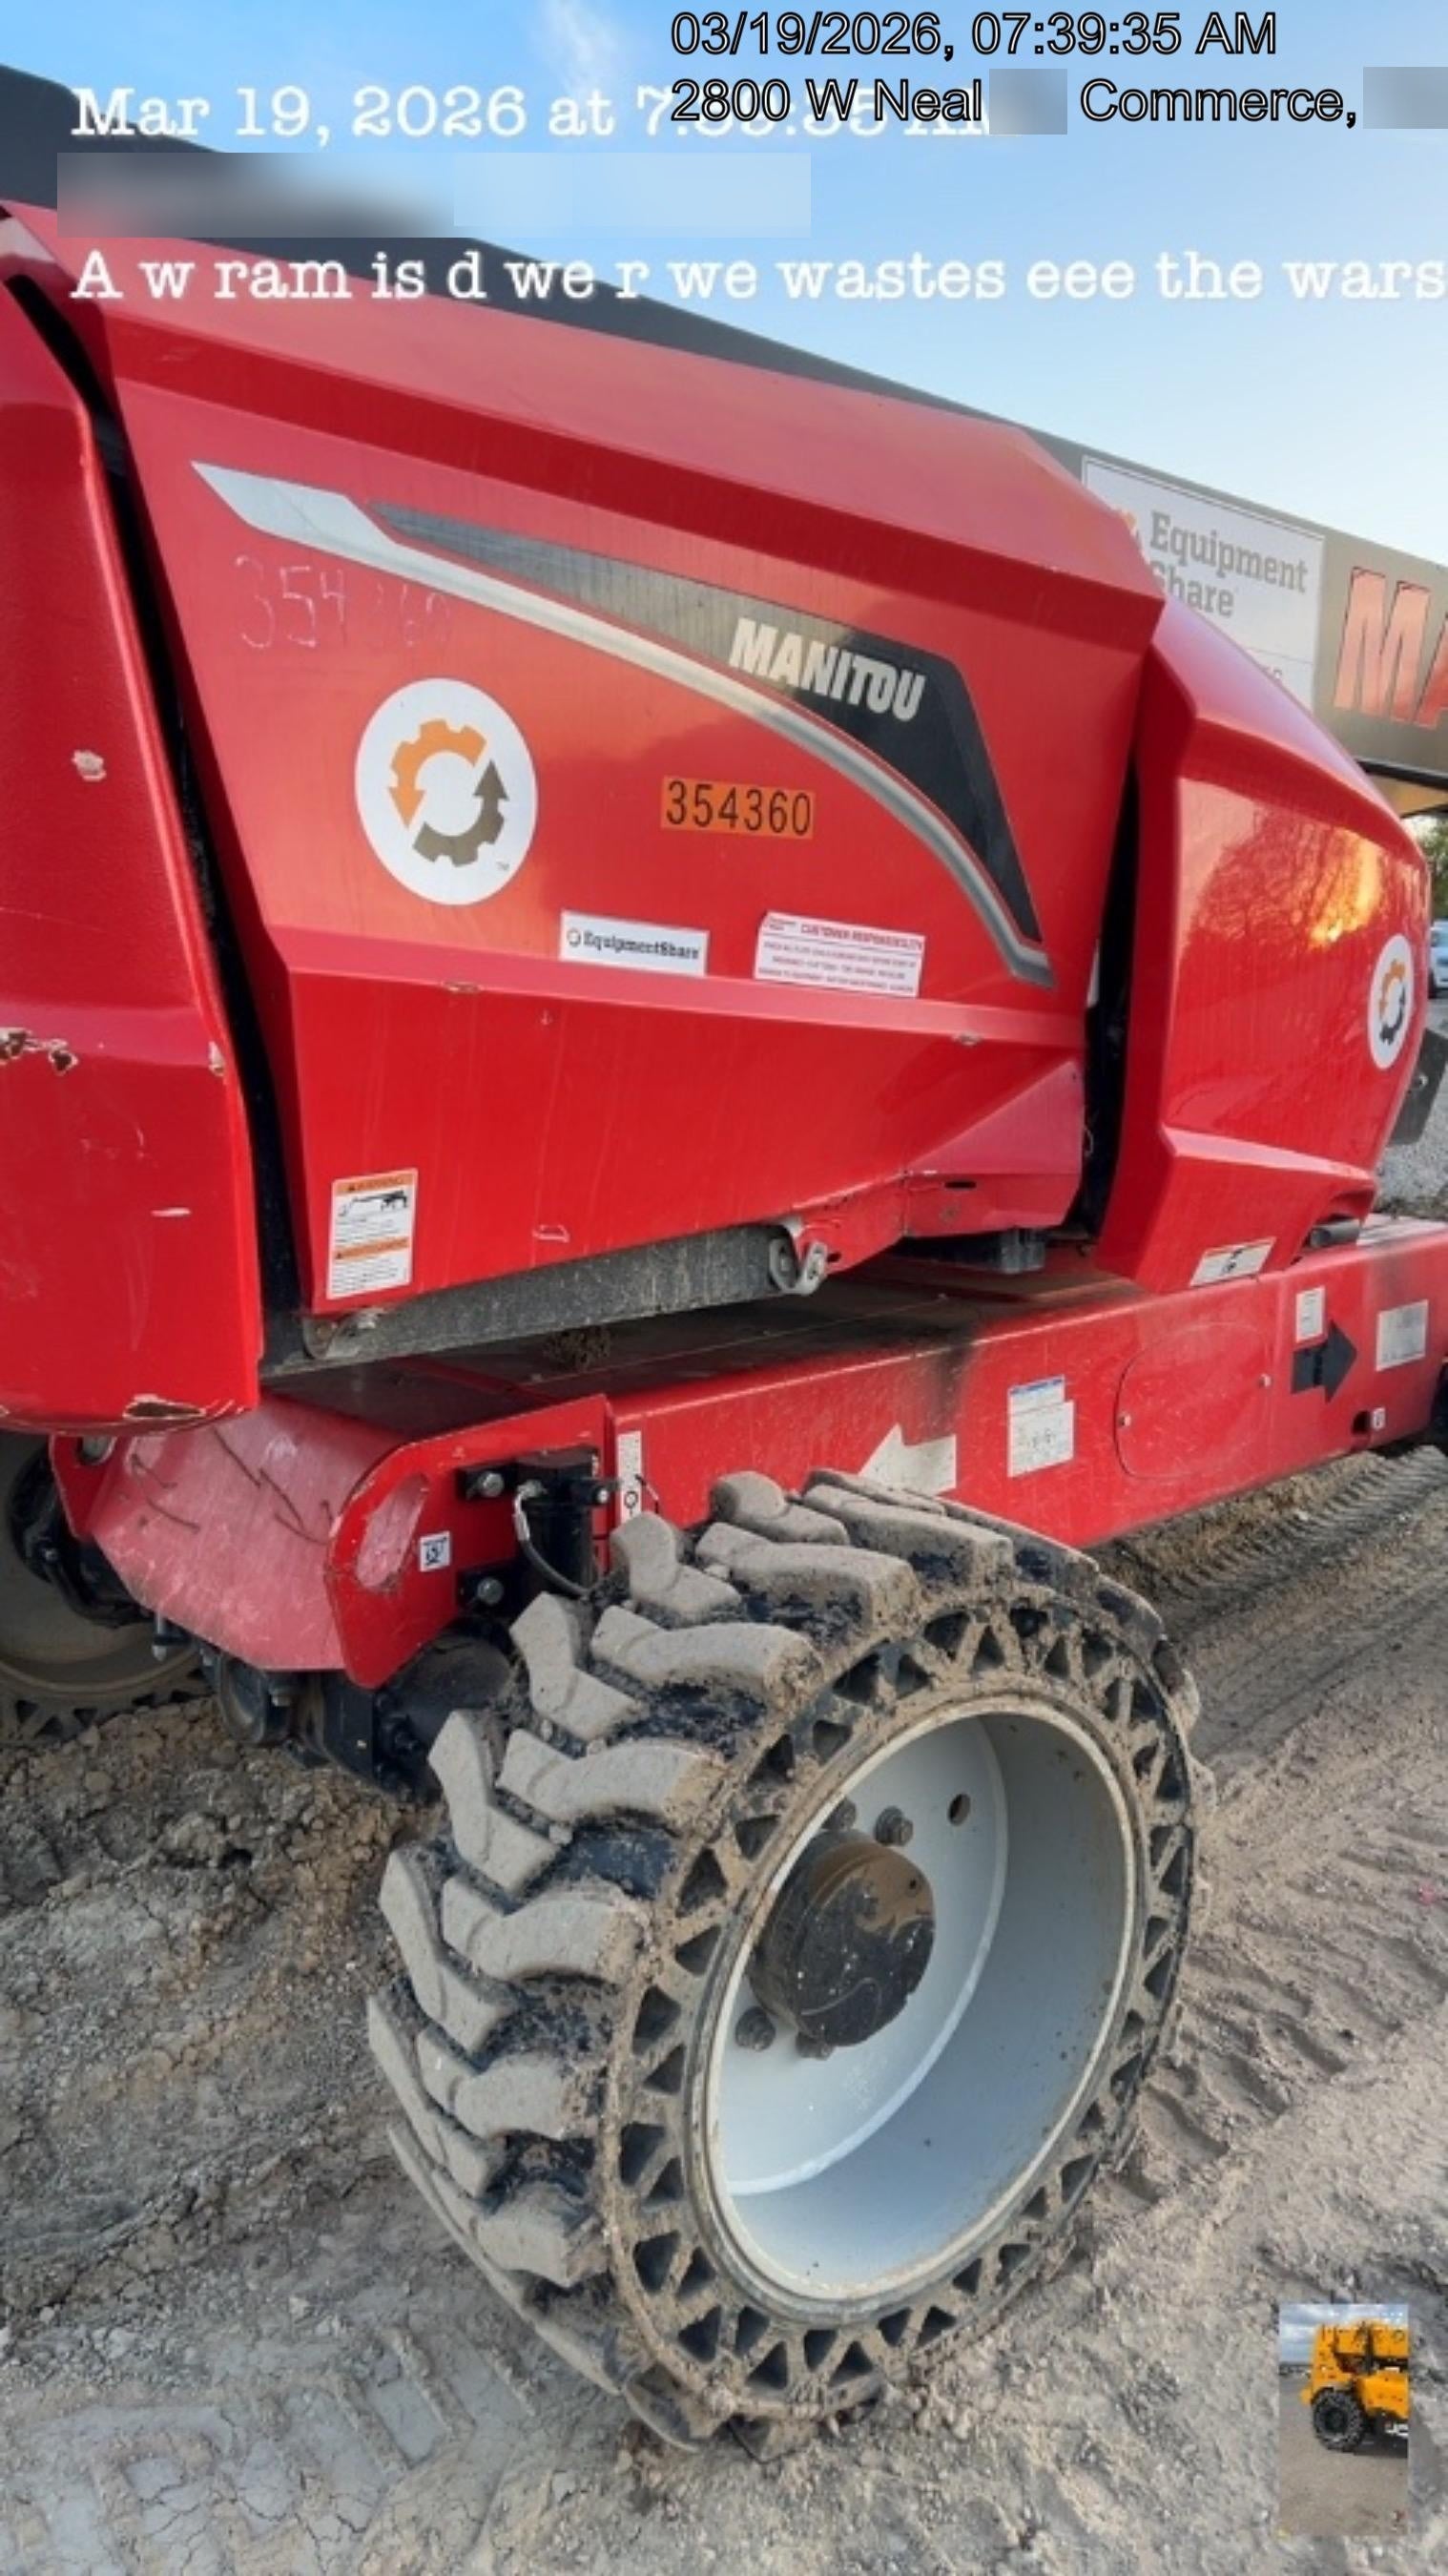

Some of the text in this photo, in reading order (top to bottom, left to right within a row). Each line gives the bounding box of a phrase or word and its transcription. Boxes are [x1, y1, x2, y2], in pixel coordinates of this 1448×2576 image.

[1149, 509, 1309, 593] Equipment
[729, 617, 926, 722] MANITOU
[666, 779, 811, 837] 354360
[583, 929, 699, 960] EquipmentShare
